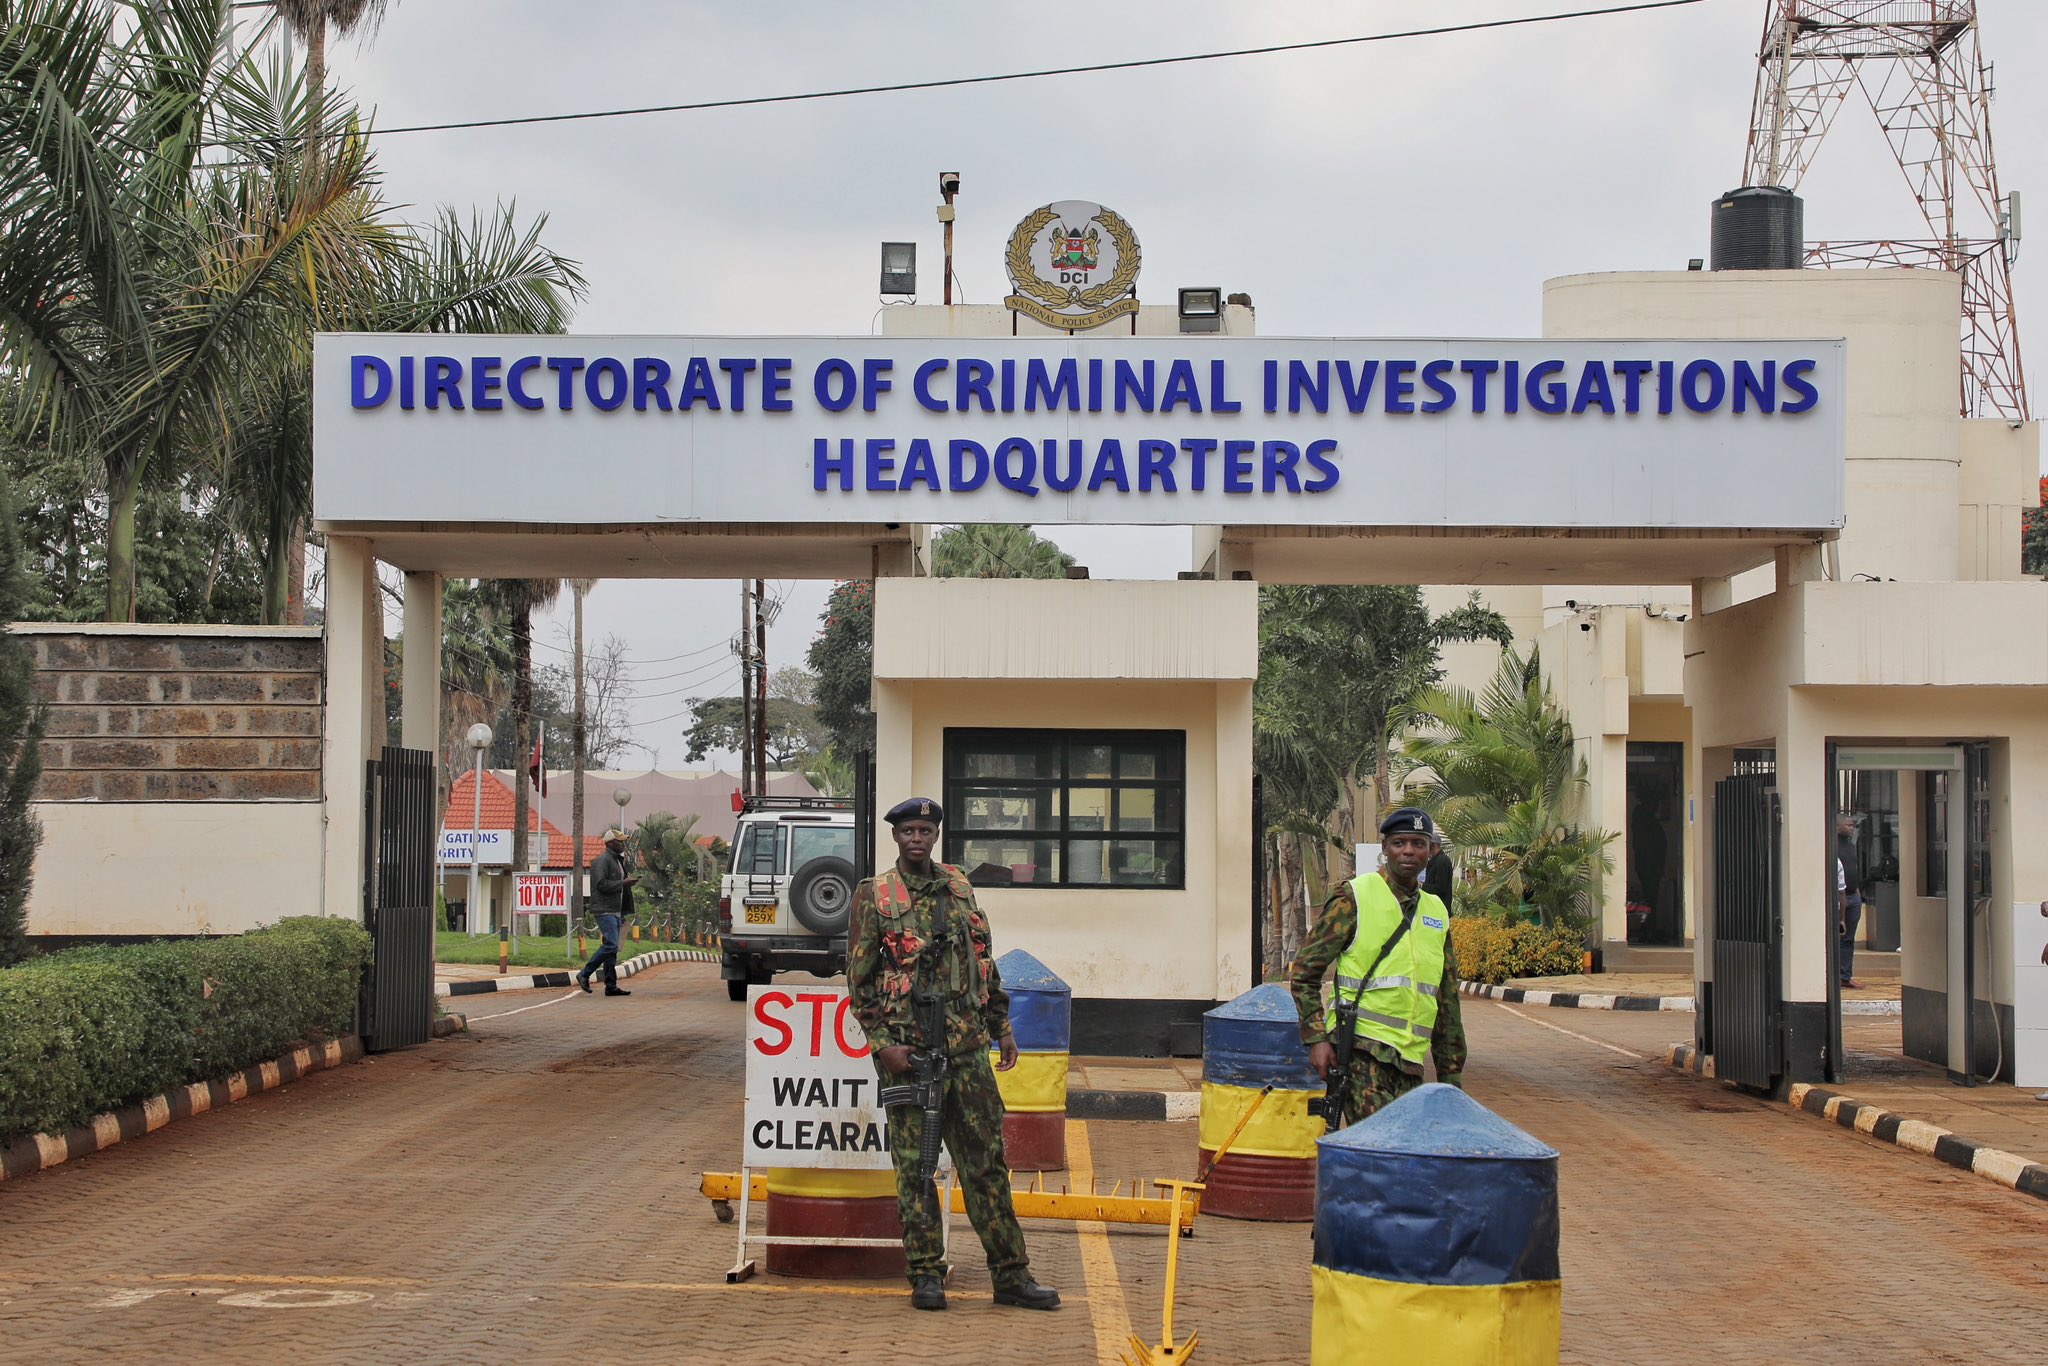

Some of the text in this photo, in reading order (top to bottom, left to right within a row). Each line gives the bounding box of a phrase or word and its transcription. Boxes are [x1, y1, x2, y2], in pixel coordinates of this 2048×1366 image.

[1060, 272, 1089, 284] DCI
[1011, 299, 1134, 326] NATIONAL POLICE SERVICE
[350, 355, 1819, 414] DIRECTORATE OF CRIMINAL INVESTIGATIONS
[813, 437, 1340, 497] HEADQUARTERS
[519, 876, 565, 885] SPEED LIMIT
[518, 885, 565, 906] 10 KP/H
[747, 913, 773, 922] 259X
[772, 1076, 869, 1109] WAIT
